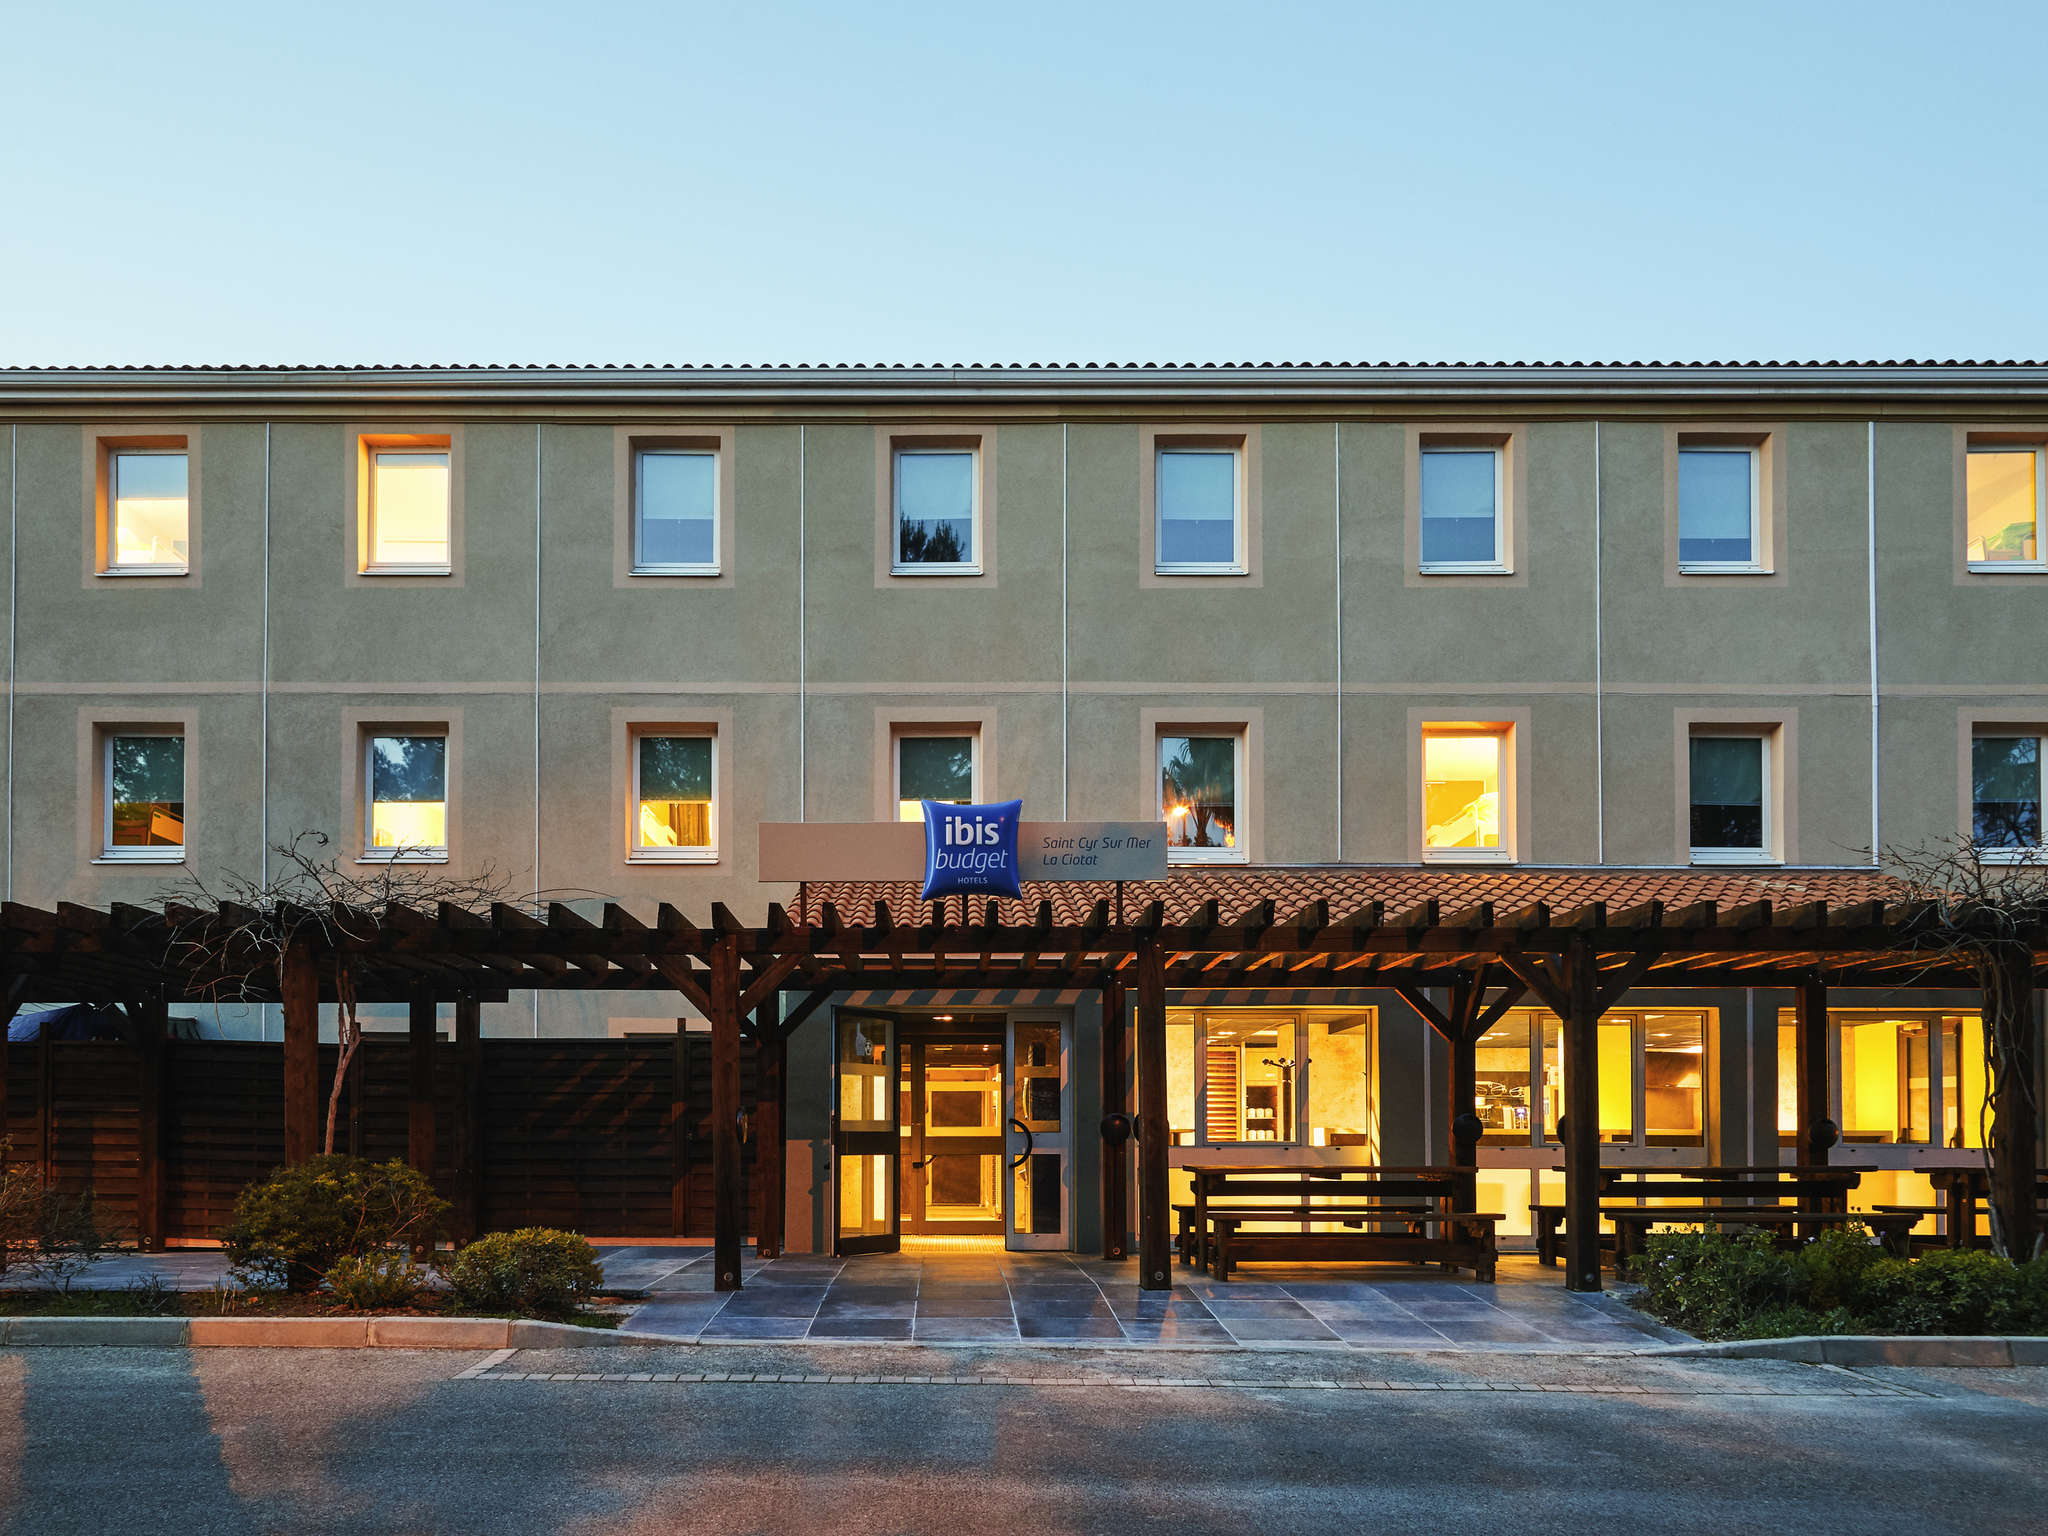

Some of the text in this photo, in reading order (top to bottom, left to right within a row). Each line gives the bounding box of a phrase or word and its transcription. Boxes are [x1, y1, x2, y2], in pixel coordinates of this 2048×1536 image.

[945, 816, 1000, 845] ibis
[1043, 837, 1151, 851] Saint Cyr Sur Mer
[936, 848, 1008, 874] budget
[1043, 854, 1098, 865] La Ciotat
